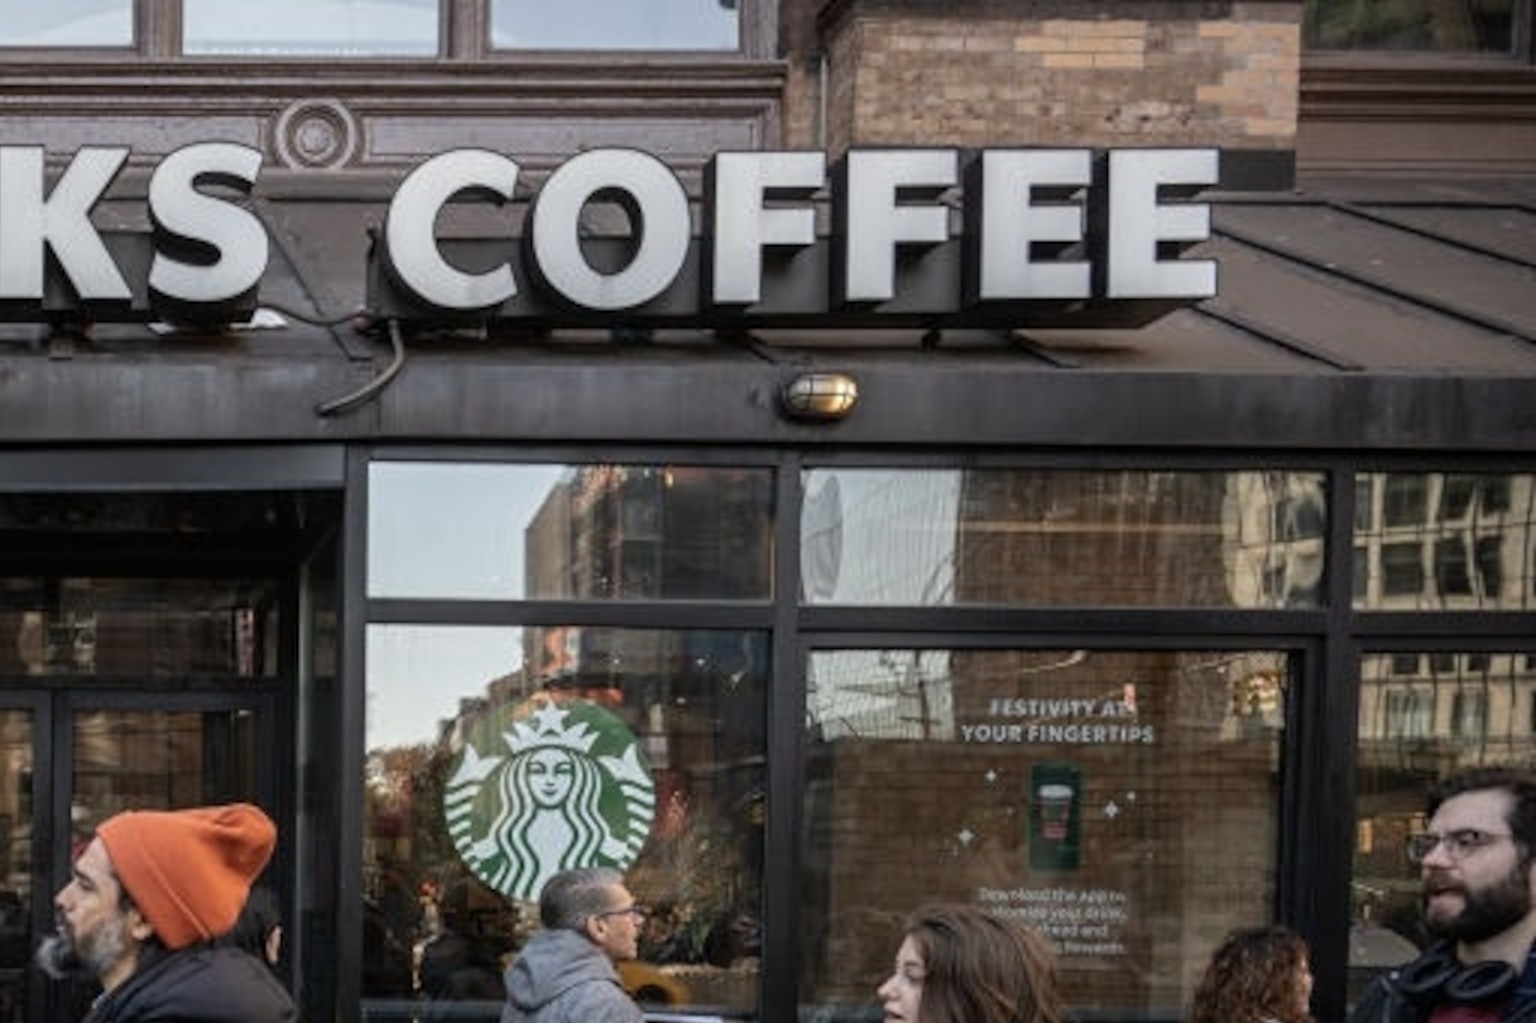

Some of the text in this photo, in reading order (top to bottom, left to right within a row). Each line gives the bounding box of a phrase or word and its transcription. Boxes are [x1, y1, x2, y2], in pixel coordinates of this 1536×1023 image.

[386, 147, 1220, 310] COFFEE
[988, 699, 1095, 717] FESTIVITY
[961, 724, 1155, 743] YOUR FINGERTIPS
